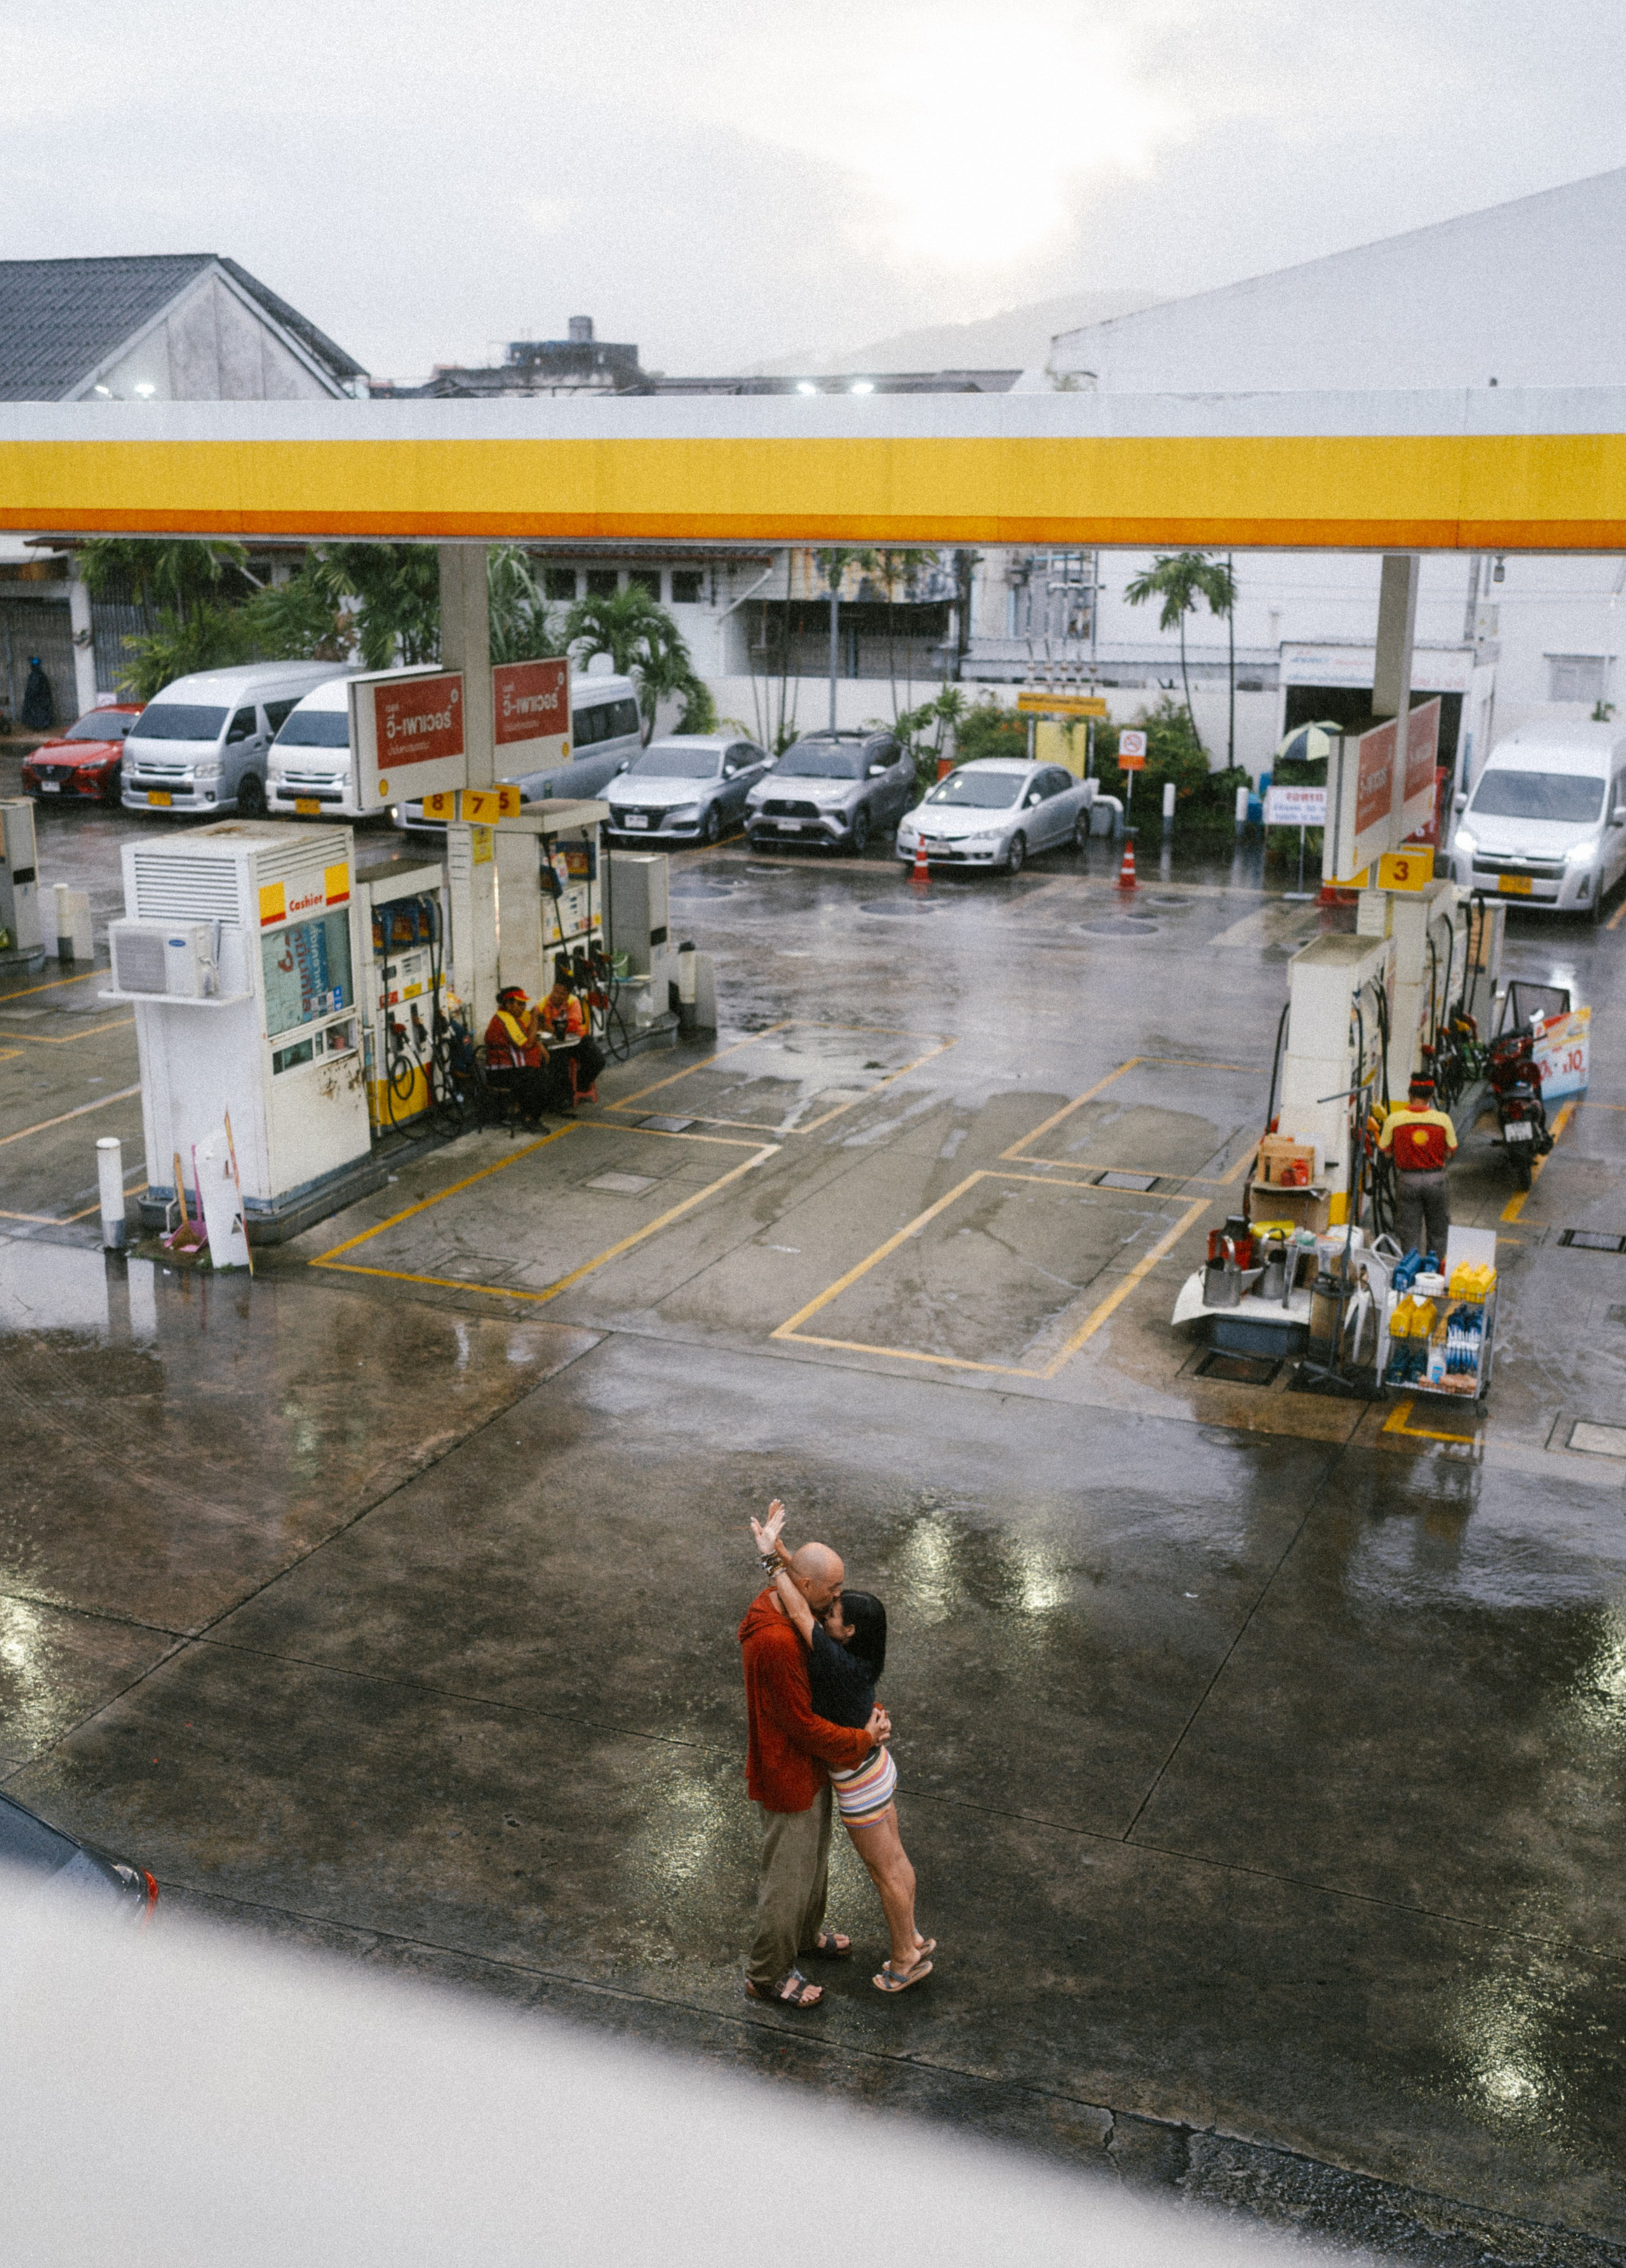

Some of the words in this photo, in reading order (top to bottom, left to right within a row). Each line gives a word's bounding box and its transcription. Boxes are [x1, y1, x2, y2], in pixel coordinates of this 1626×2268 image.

[432, 793, 444, 811] 8
[473, 796, 485, 814] 7
[499, 791, 510, 810] 5
[1392, 861, 1409, 882] 3
[288, 894, 323, 912] Cashier
